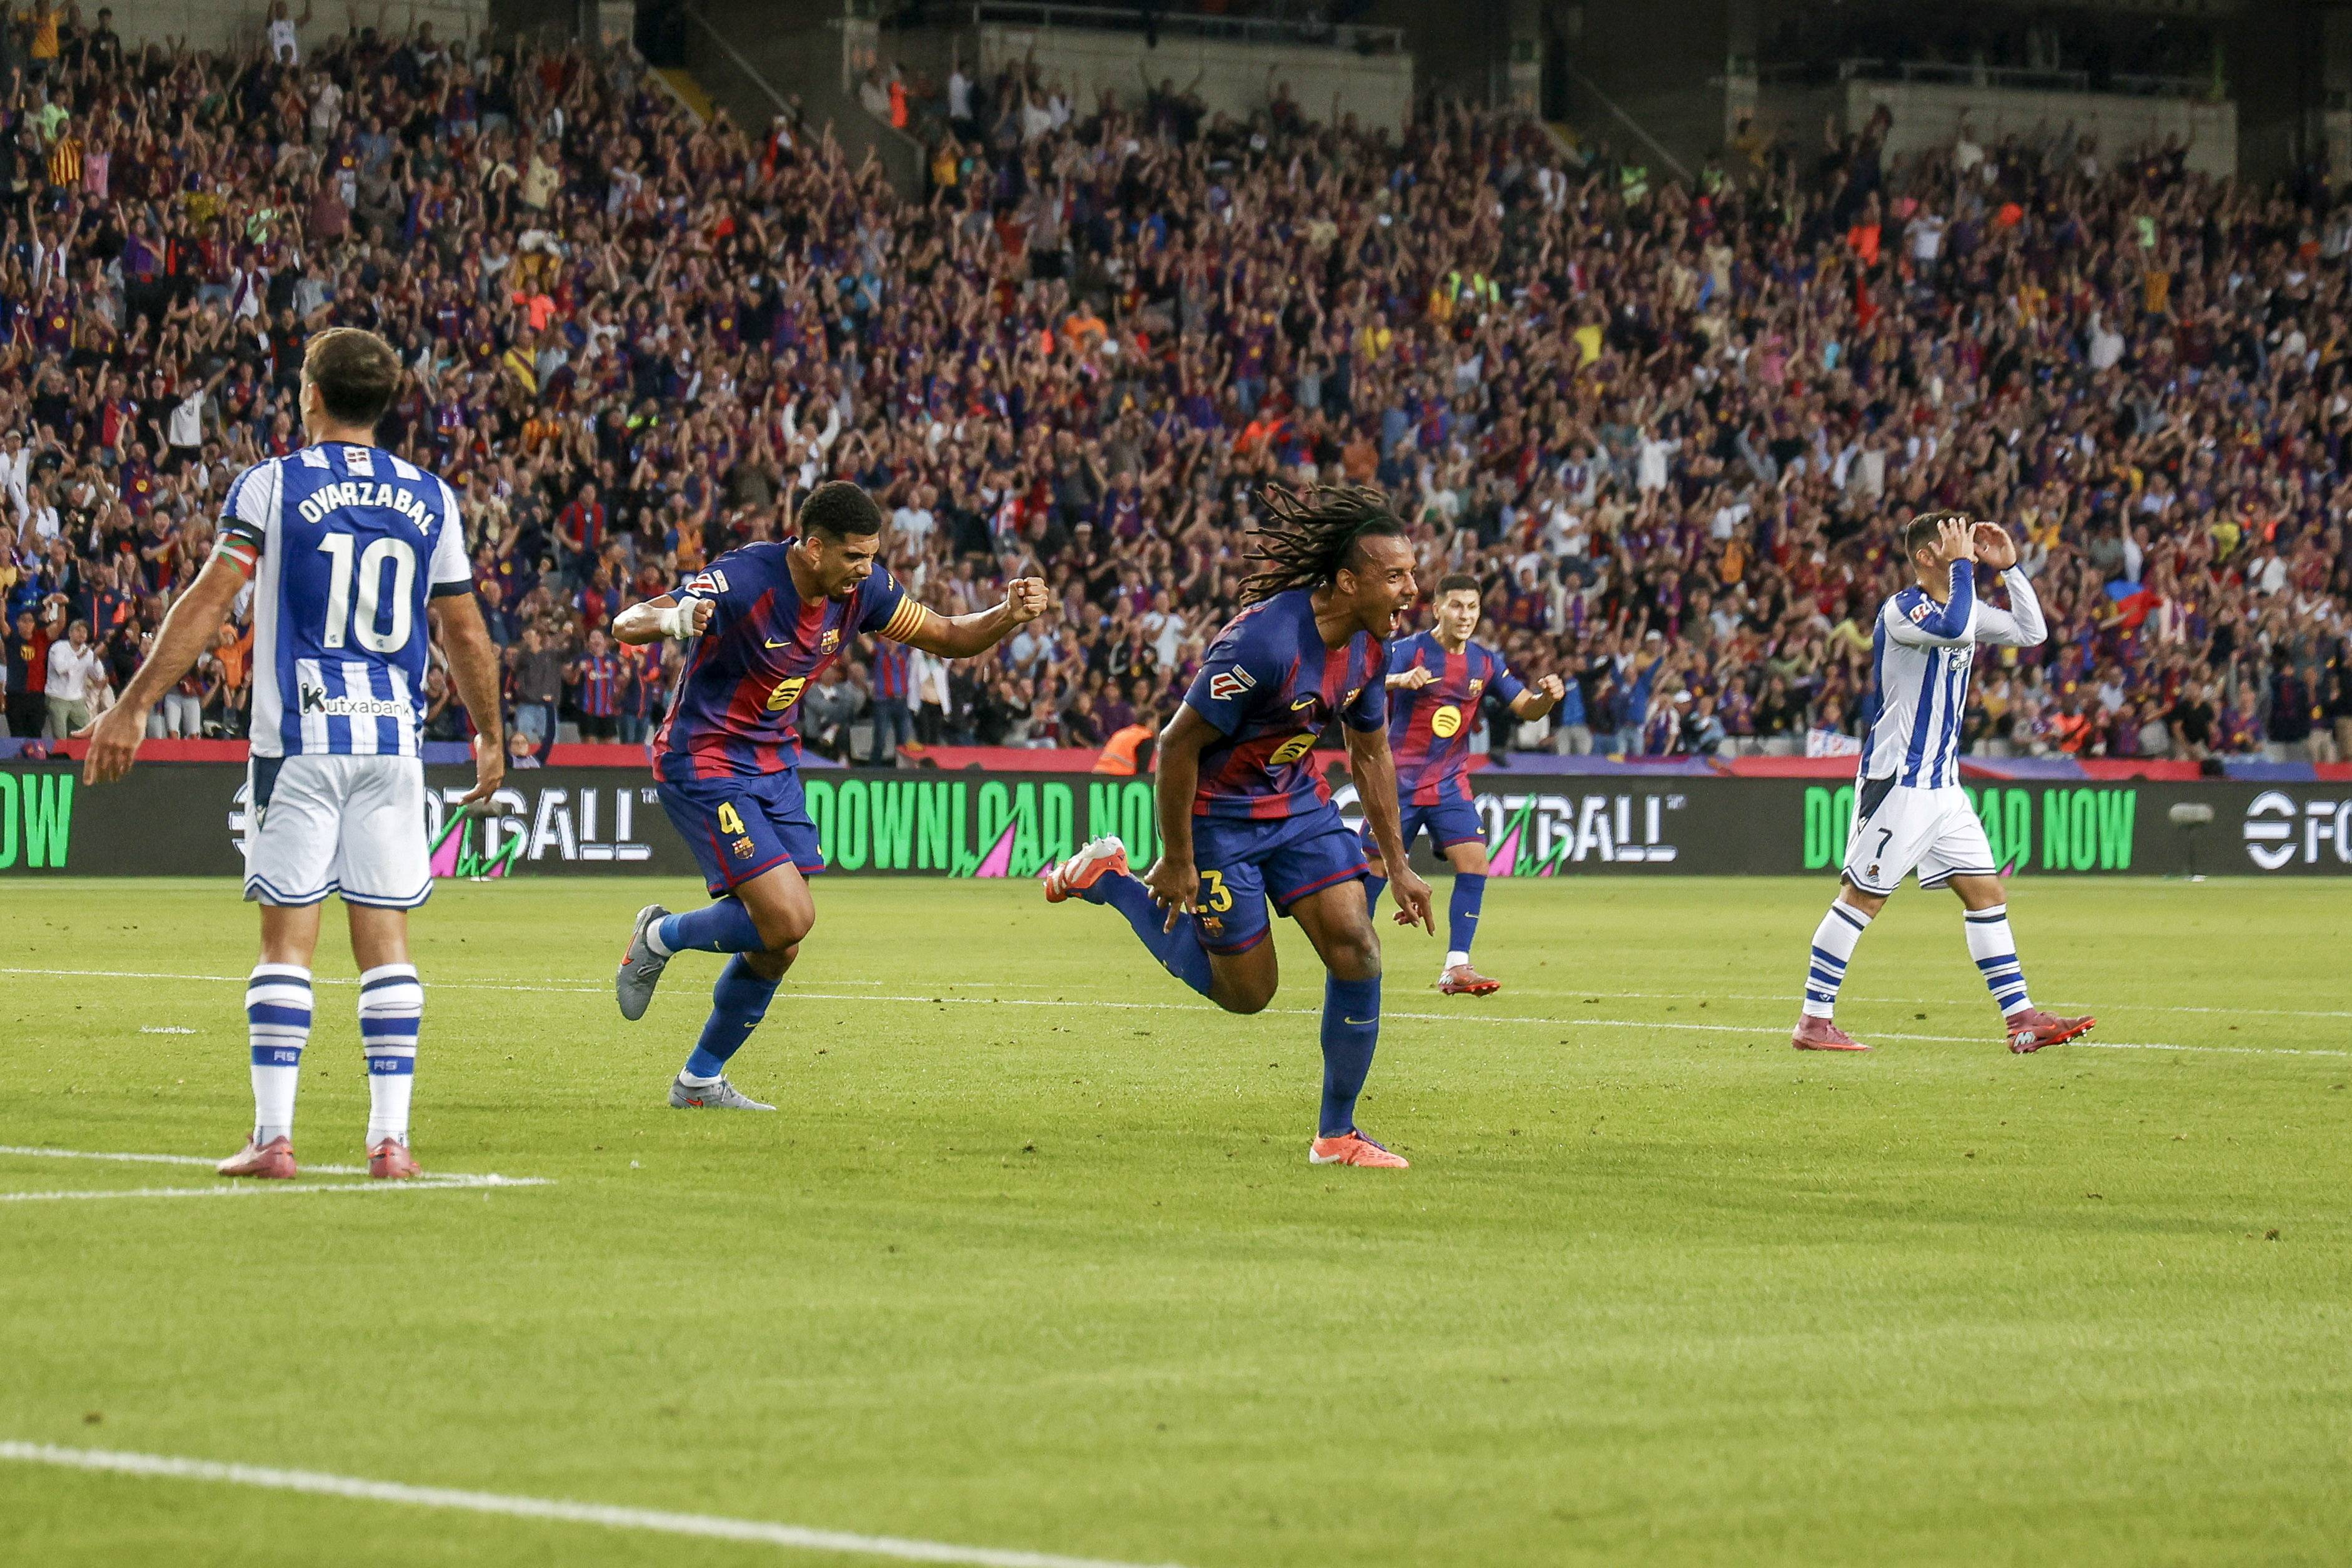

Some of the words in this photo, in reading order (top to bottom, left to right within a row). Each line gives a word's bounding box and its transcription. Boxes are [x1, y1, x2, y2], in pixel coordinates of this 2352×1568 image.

[297, 481, 435, 537] OYARZABAL
[316, 532, 417, 653] 10
[302, 683, 411, 717] Kutxabank
[718, 801, 746, 834] 4
[1089, 782, 1164, 870] NO
[2042, 789, 2137, 870] NOW
[1875, 827, 1893, 859] 7
[1195, 870, 1233, 912] 3
